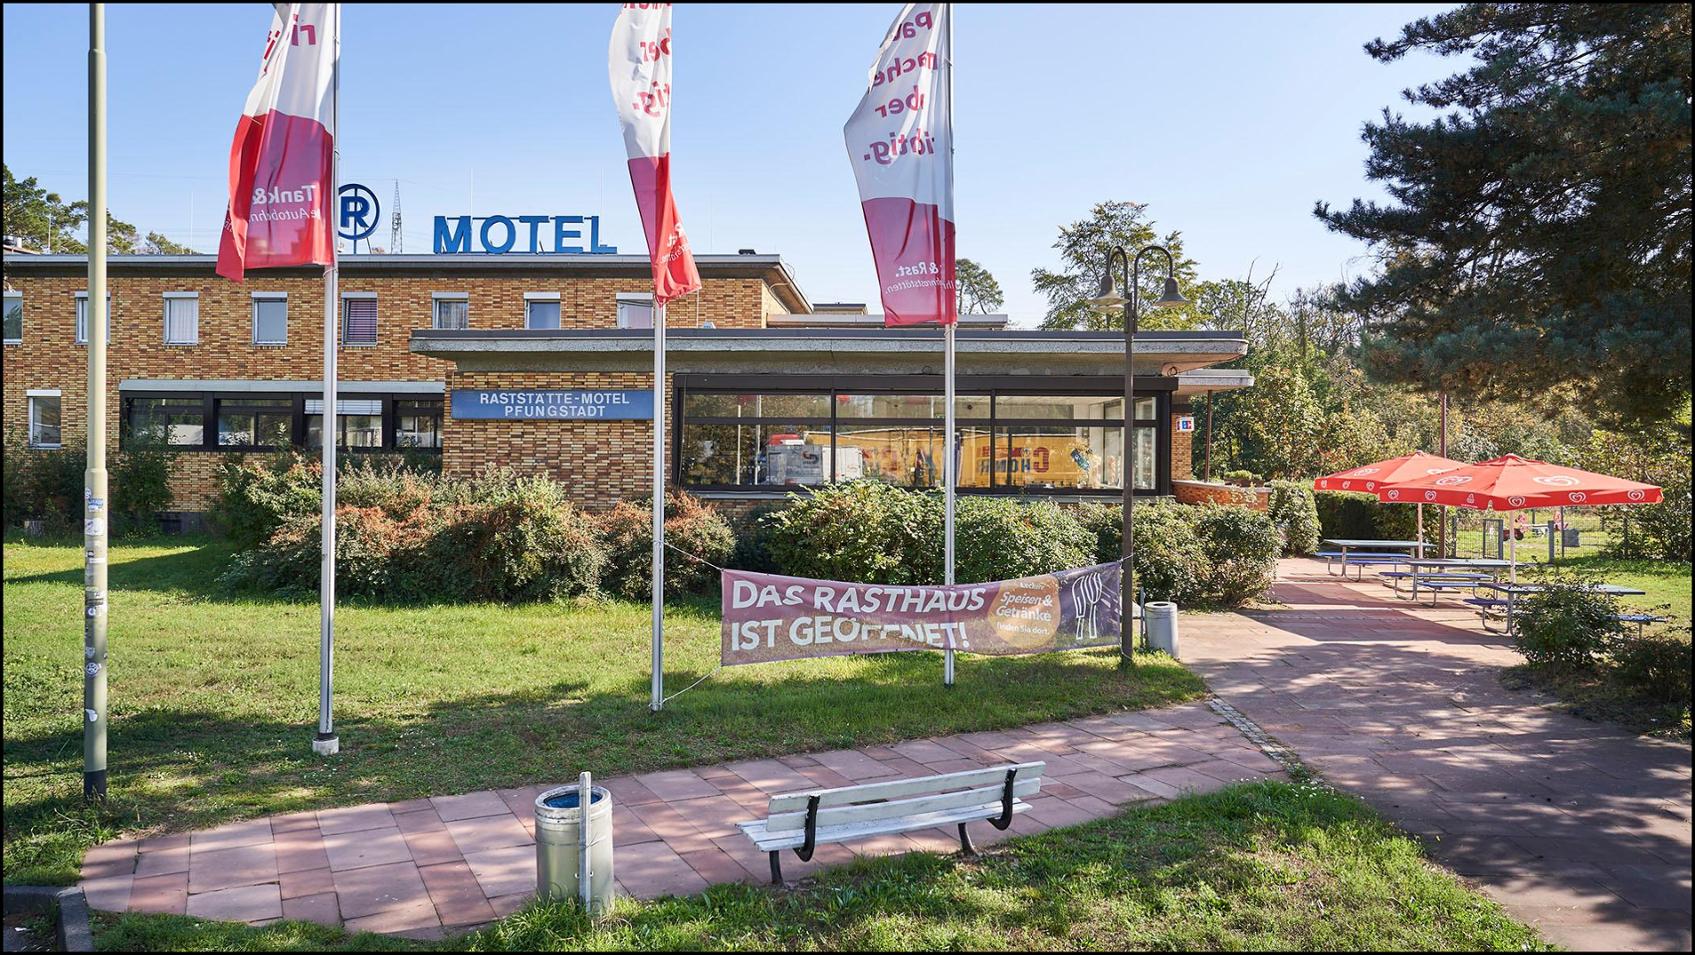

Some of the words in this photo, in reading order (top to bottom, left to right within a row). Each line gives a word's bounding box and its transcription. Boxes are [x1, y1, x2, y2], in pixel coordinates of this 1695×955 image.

[341, 196, 370, 228] R
[433, 215, 617, 254] MOTEL
[480, 392, 630, 404] RASTSTÄTTE-MOTEL
[505, 405, 606, 417] PFUNGSTADT
[732, 580, 805, 609] DAS
[814, 586, 986, 613] RASTHAUS
[1000, 591, 1042, 606] Speisen
[1042, 594, 1053, 607] &
[996, 605, 1052, 622] Getränke
[731, 619, 783, 651] IST
